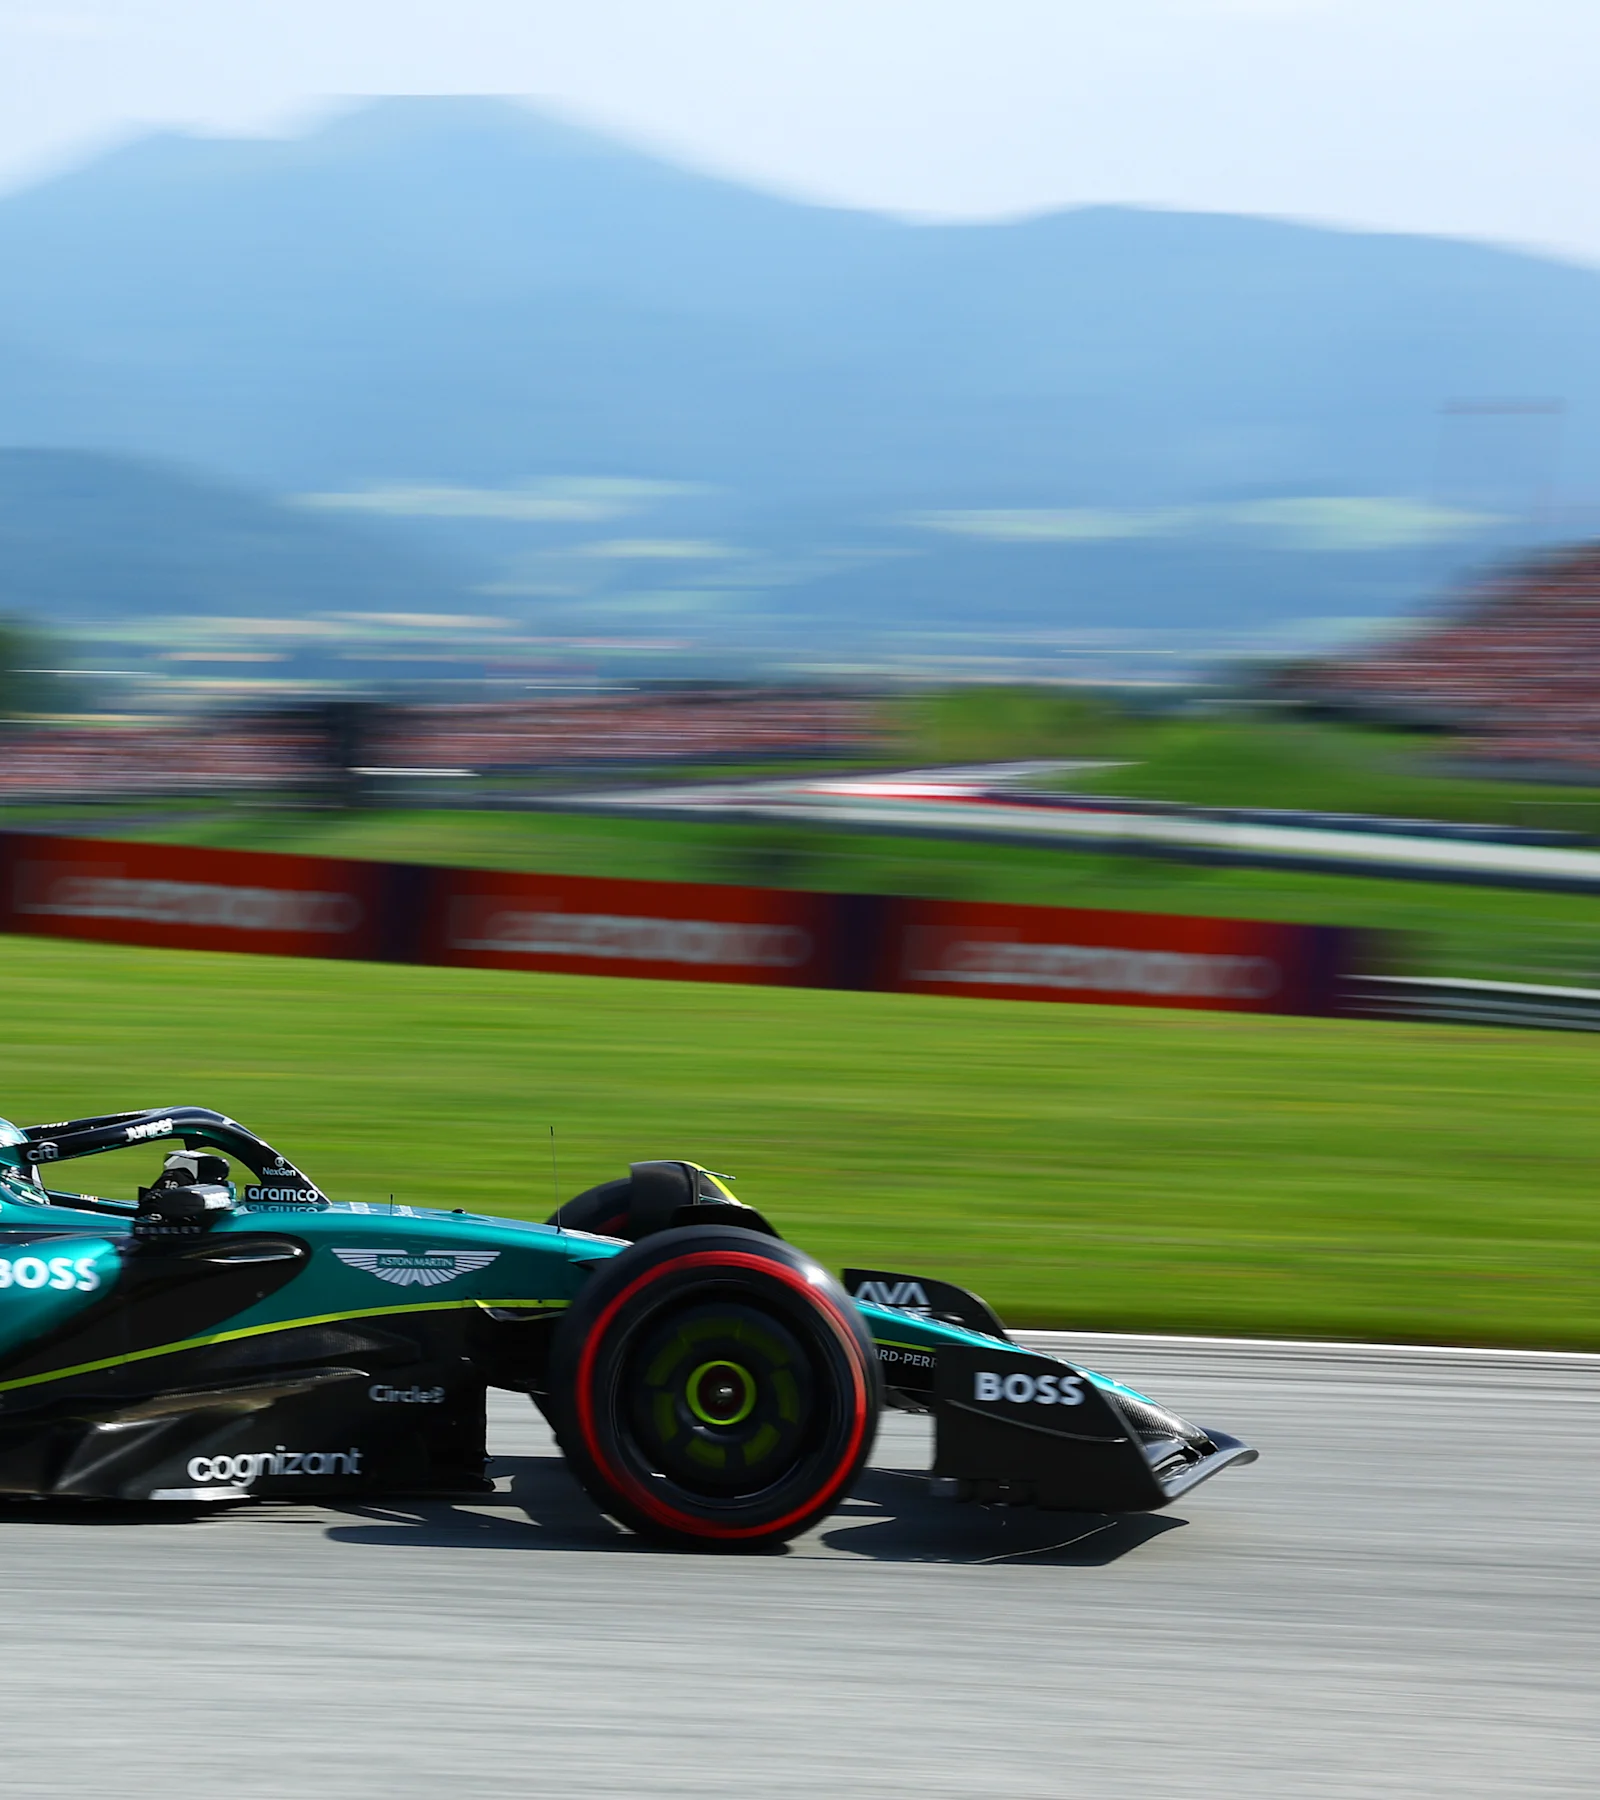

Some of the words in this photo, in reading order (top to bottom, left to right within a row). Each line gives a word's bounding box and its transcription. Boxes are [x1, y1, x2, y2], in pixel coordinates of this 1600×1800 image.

[26, 1142, 59, 1161] citi
[262, 1167, 297, 1176] NexGen
[248, 1187, 319, 1202] aramco
[379, 1256, 411, 1266] ASTON
[413, 1257, 453, 1267] MARTIN
[855, 1281, 931, 1305] AVA
[974, 1371, 1085, 1406] BOSS
[187, 1445, 363, 1487] cognizant
